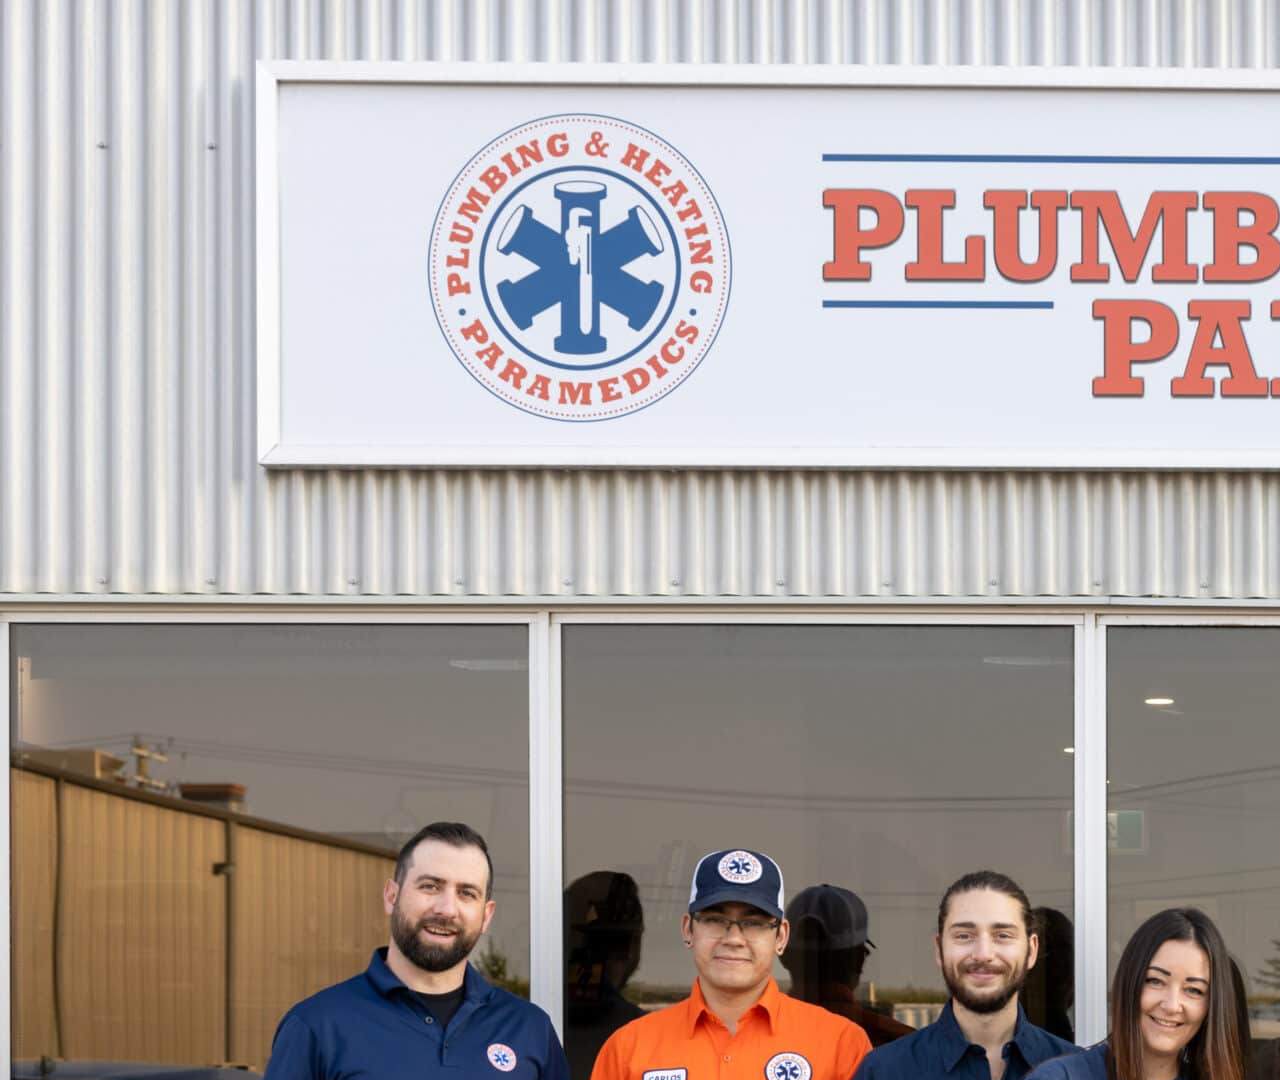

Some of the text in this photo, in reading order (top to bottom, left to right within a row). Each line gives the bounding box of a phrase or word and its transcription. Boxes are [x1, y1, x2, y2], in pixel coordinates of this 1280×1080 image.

[446, 131, 714, 297] PLUMBING & HEATING
[460, 318, 699, 406] PARAMEDICS
